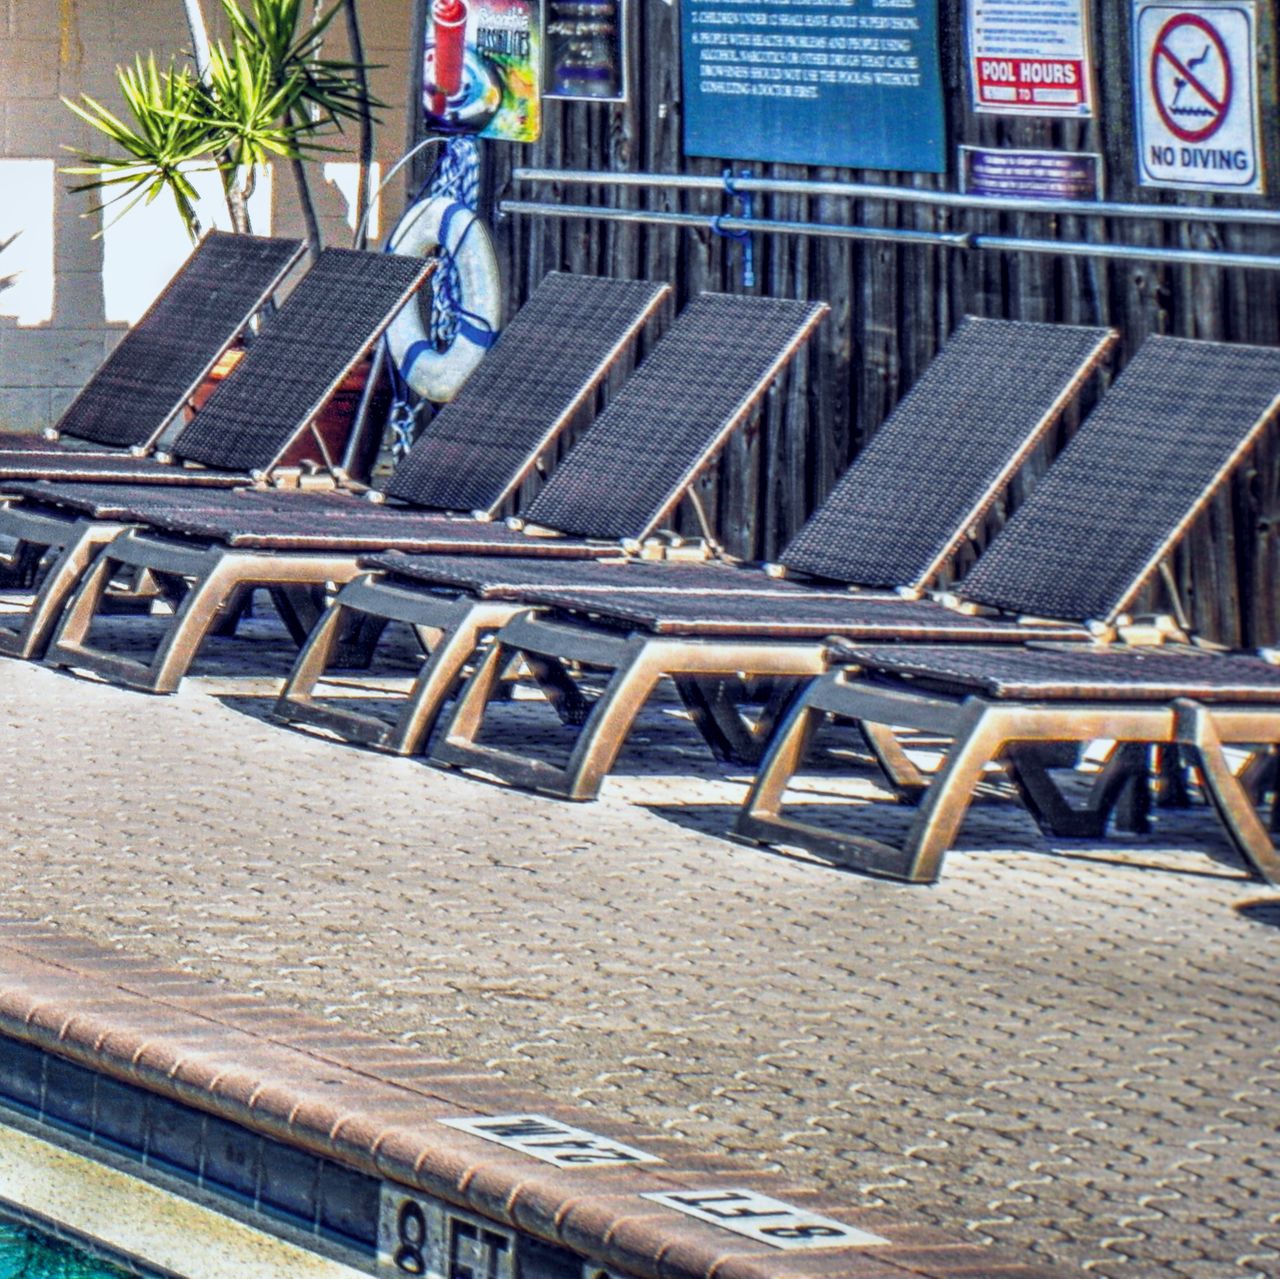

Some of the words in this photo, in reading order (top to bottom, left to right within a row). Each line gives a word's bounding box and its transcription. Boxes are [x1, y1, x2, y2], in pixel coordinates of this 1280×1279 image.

[981, 61, 1016, 82] POOL
[1020, 62, 1076, 84] HOURS
[1151, 145, 1175, 166] NO
[1181, 147, 1248, 170] DIVING
[393, 1199, 426, 1275] 8
[759, 1225, 847, 1238] 8
